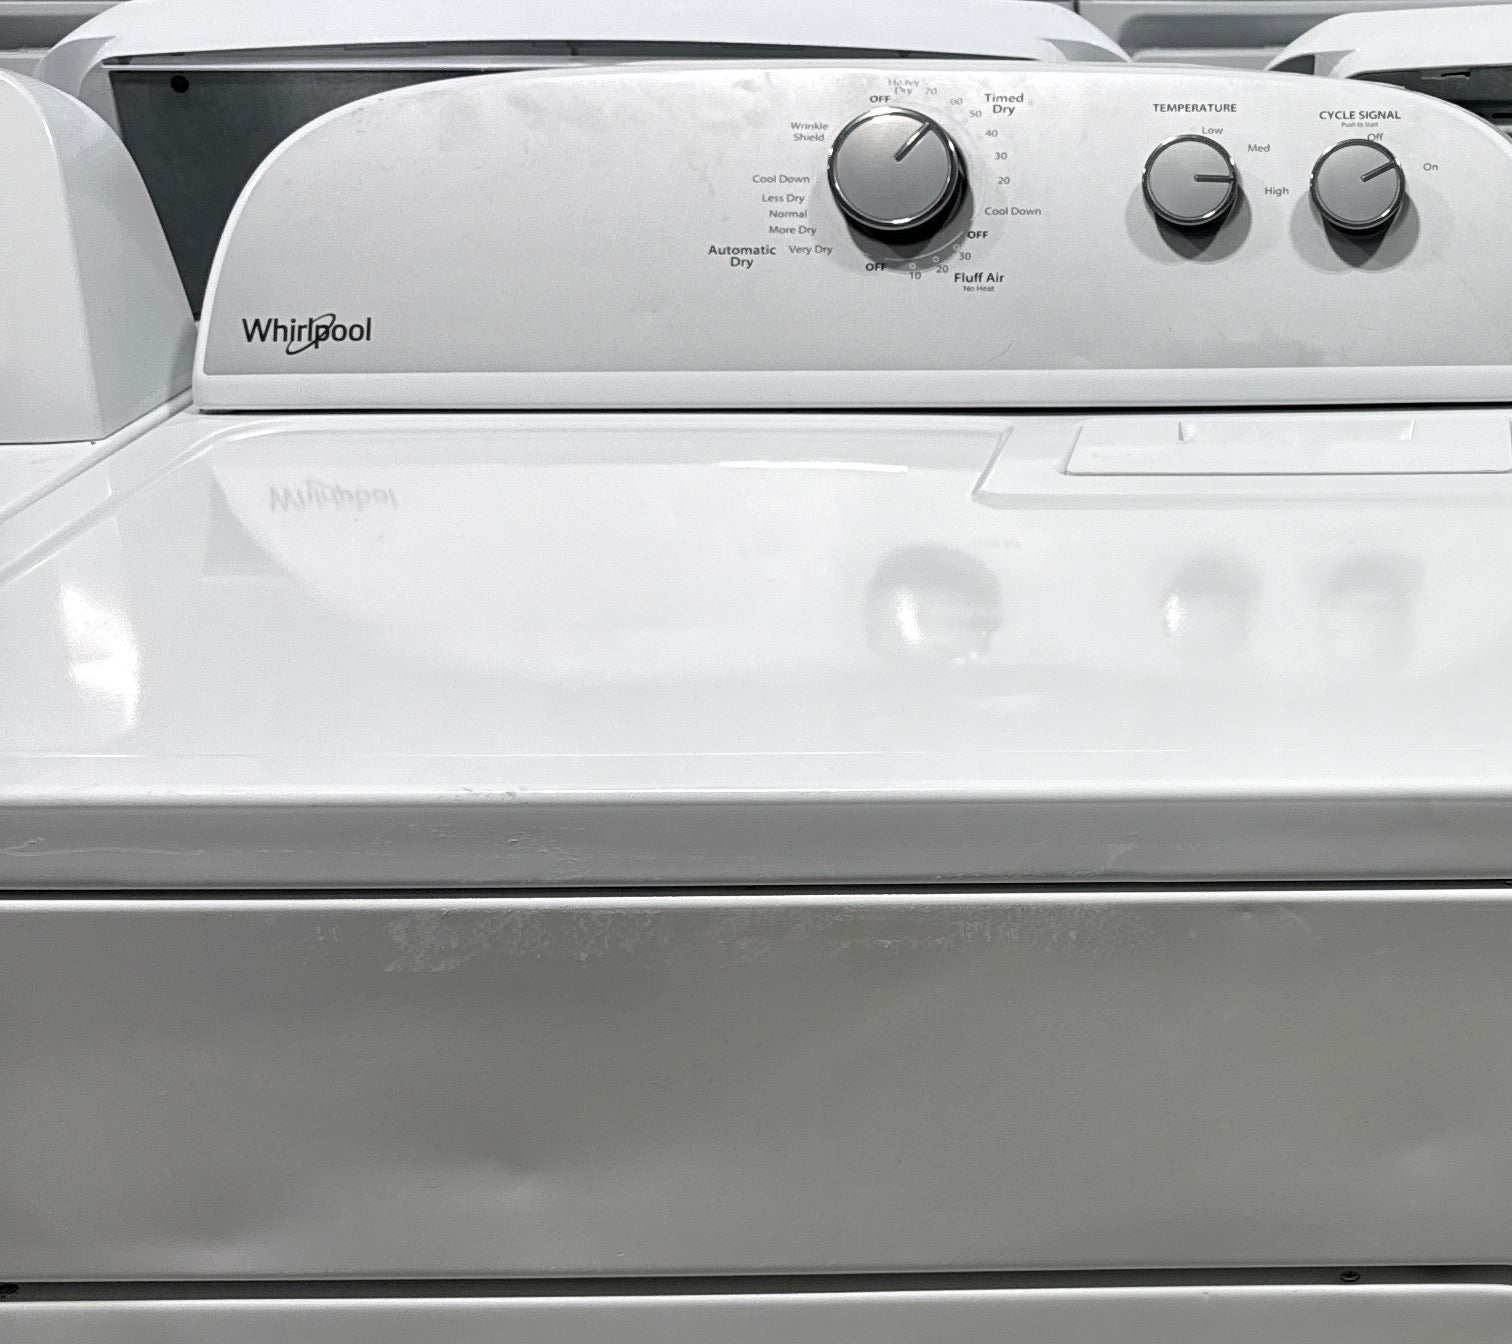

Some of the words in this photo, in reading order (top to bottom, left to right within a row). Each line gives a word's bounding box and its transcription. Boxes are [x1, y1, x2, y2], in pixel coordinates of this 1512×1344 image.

[925, 88, 938, 96] 70
[869, 95, 891, 103] OFF
[984, 93, 1024, 103] Timed
[992, 104, 1016, 116] Dry
[1153, 103, 1237, 113] TEMPERATURE
[970, 110, 982, 118] 50
[1319, 111, 1356, 120] CYCLE
[1359, 111, 1401, 120] SIGNAL
[790, 121, 829, 131] Wrinkle
[985, 129, 998, 137] 40
[1202, 127, 1224, 135] Low
[793, 132, 825, 142] Shield
[1367, 133, 1384, 142] Off
[1247, 144, 1270, 152] Med
[995, 152, 1008, 160] 30
[1423, 162, 1438, 171] On
[752, 174, 777, 183] Cool
[779, 174, 810, 183] Down
[997, 177, 1010, 185] 20
[1265, 186, 1289, 197] High
[762, 194, 785, 203] Less
[787, 194, 805, 205] Dry
[769, 209, 808, 219] Normal
[984, 207, 1008, 216] Cool
[1011, 207, 1042, 216] Down
[769, 226, 793, 235] More
[796, 225, 817, 236] Dry
[967, 230, 988, 239] OFF
[708, 245, 777, 256] Automatic
[788, 246, 812, 257] Very
[815, 245, 833, 256] Dry
[959, 252, 971, 261] 30
[730, 257, 754, 269] Dry
[865, 262, 887, 271] OFF
[936, 265, 949, 274] 20
[910, 271, 921, 280] 10
[954, 273, 982, 283] Fluff
[985, 273, 1004, 283] Air
[242, 317, 371, 349] Whirlpool
